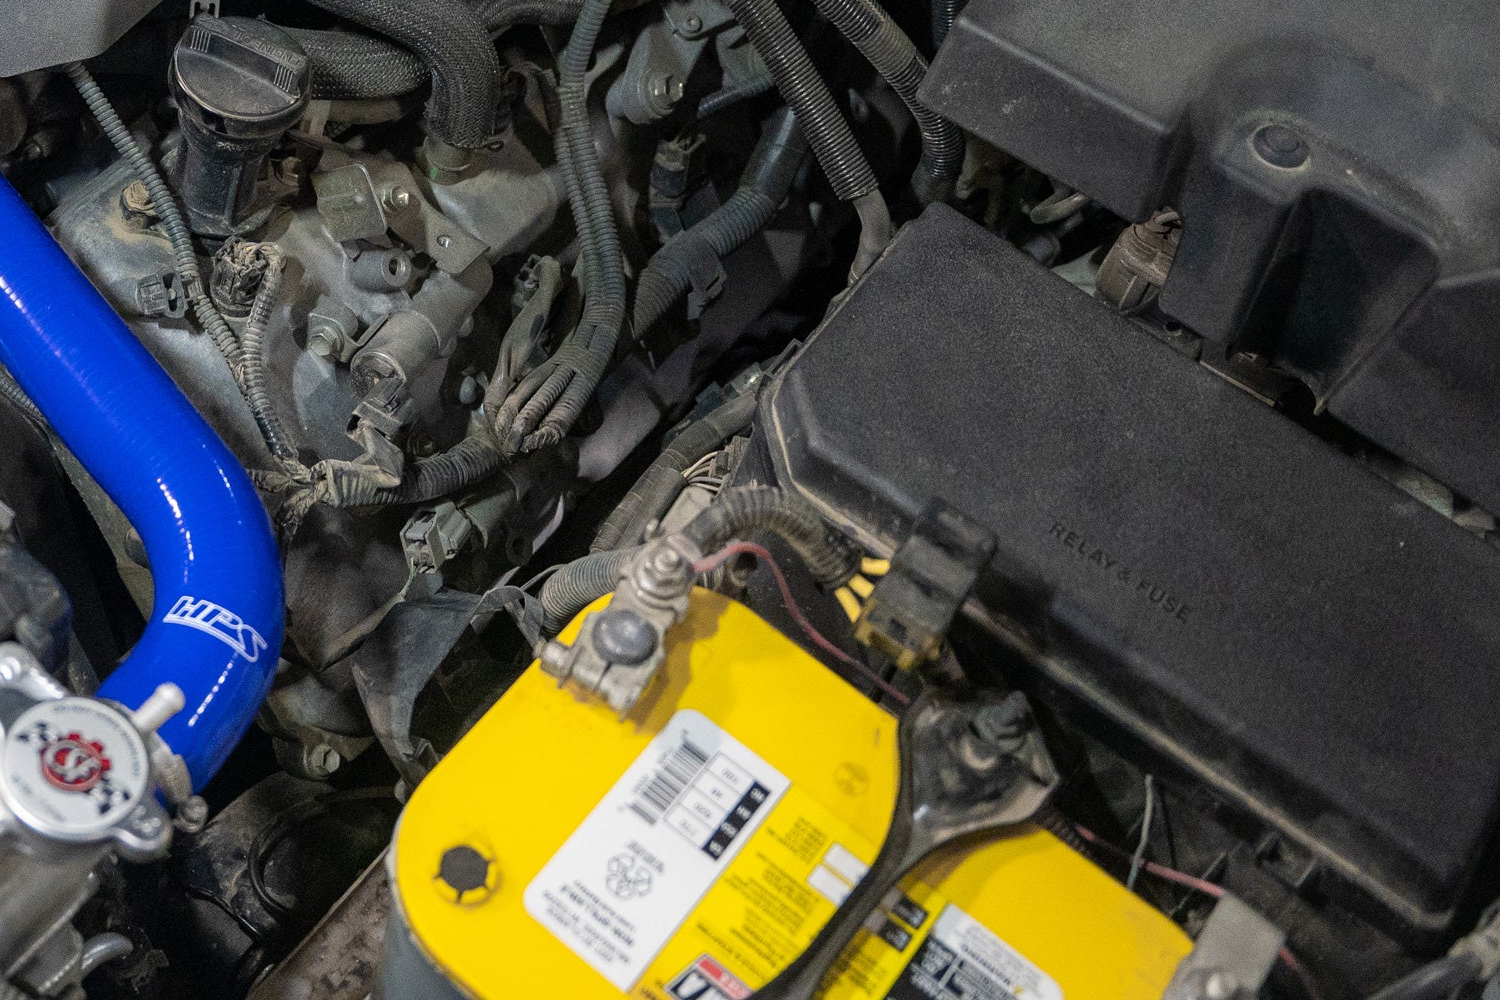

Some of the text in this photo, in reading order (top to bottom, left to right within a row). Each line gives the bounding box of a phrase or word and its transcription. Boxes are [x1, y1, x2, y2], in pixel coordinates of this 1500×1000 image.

[254, 40, 299, 65] ENGINE
[1049, 522, 1191, 622] RELAY & FUSE
[163, 595, 268, 663] HPS
